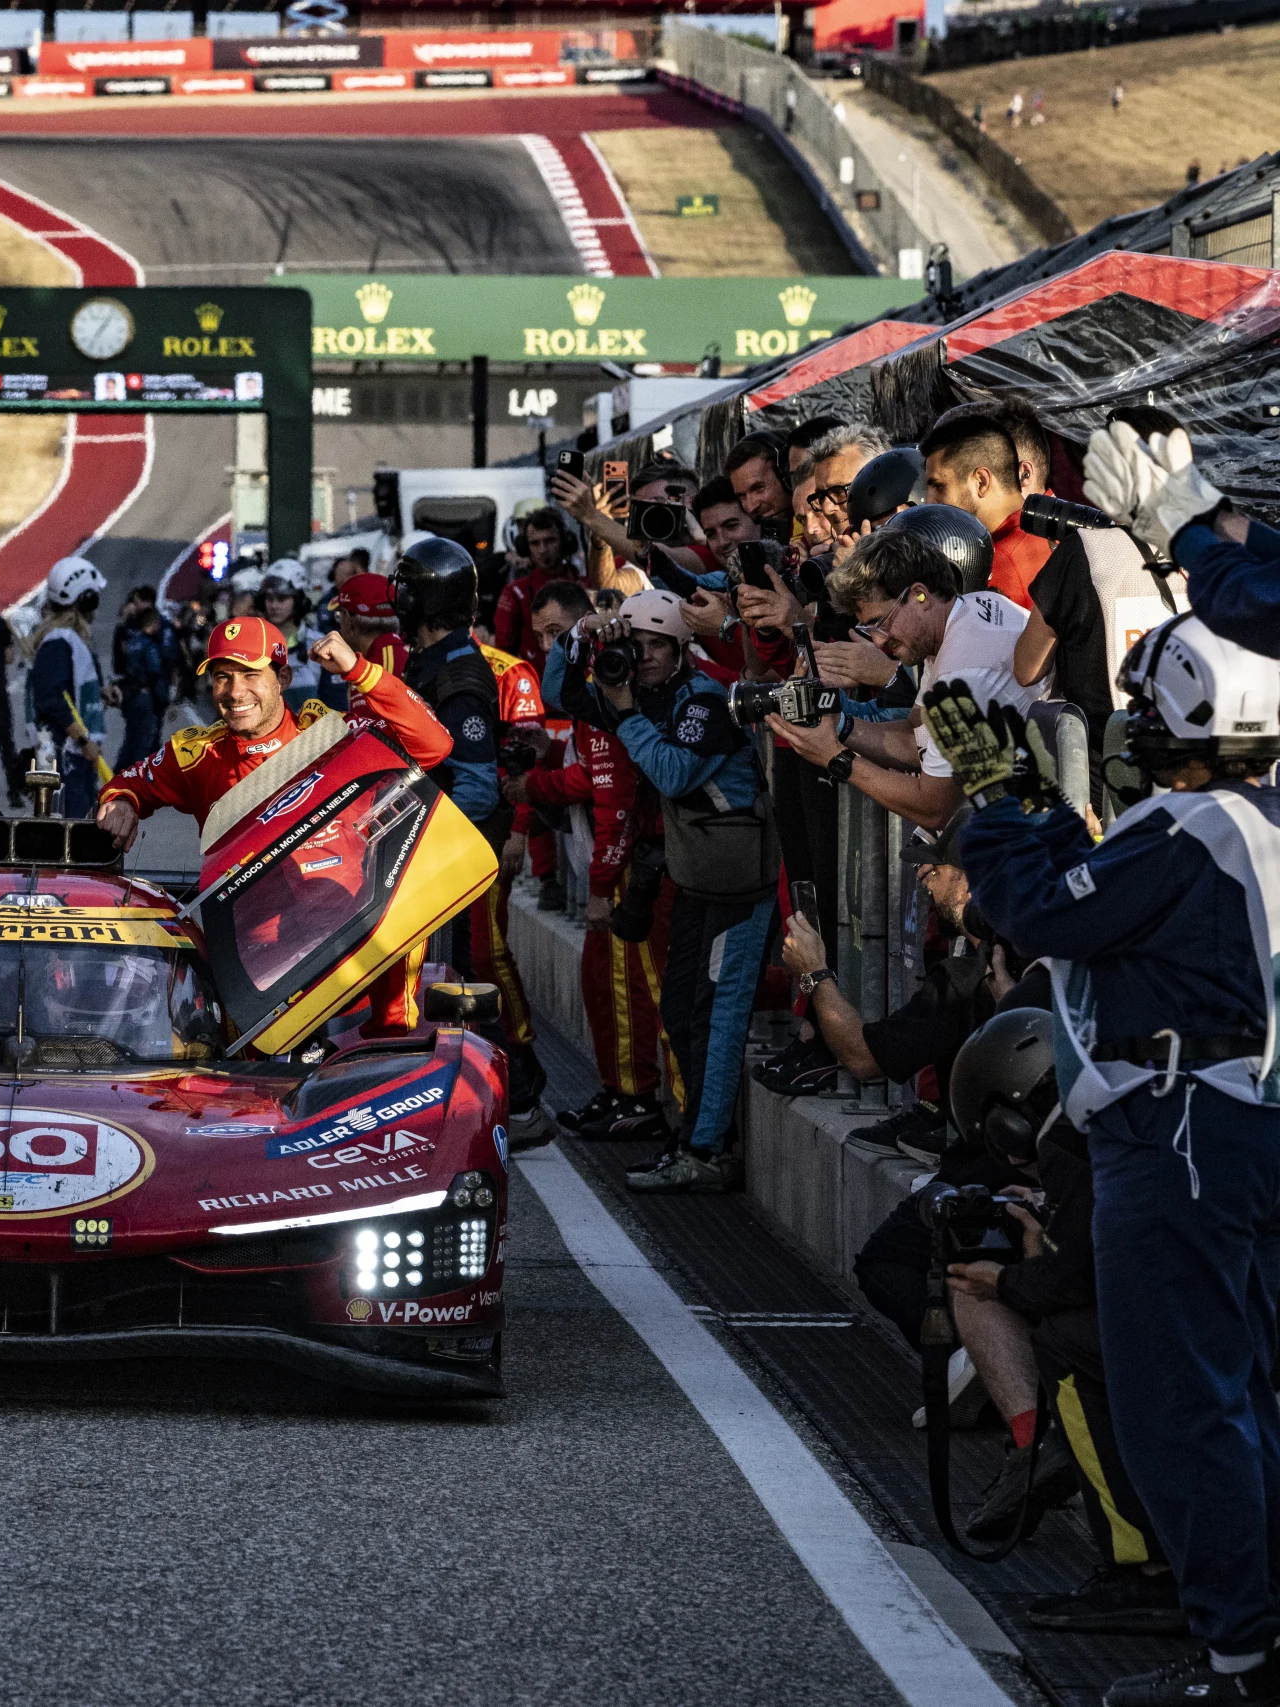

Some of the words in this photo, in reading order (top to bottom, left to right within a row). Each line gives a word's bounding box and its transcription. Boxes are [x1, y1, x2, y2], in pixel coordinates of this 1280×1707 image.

[163, 337, 257, 358] ROLEX
[312, 328, 436, 357] ROLEX
[524, 329, 647, 358] ROLEX
[735, 330, 832, 357] ROL
[508, 388, 558, 417] LAP
[686, 704, 710, 720] OMP
[592, 773, 614, 786] NGK
[226, 884, 237, 895] A.
[234, 861, 264, 889] FUOCO
[269, 845, 282, 858] M.
[279, 822, 312, 852] MOLINA
[318, 807, 330, 819] N.
[327, 781, 361, 813] NIELSEN
[384, 804, 428, 889] @FerrariHypercar
[278, 1125, 354, 1155] ADLER
[375, 1087, 445, 1121] GROUP
[370, 1141, 437, 1167] LOGISTICS
[197, 1183, 334, 1212] RICHARD
[338, 1163, 428, 1192] MILLE
[377, 1302, 473, 1323] V-Power
